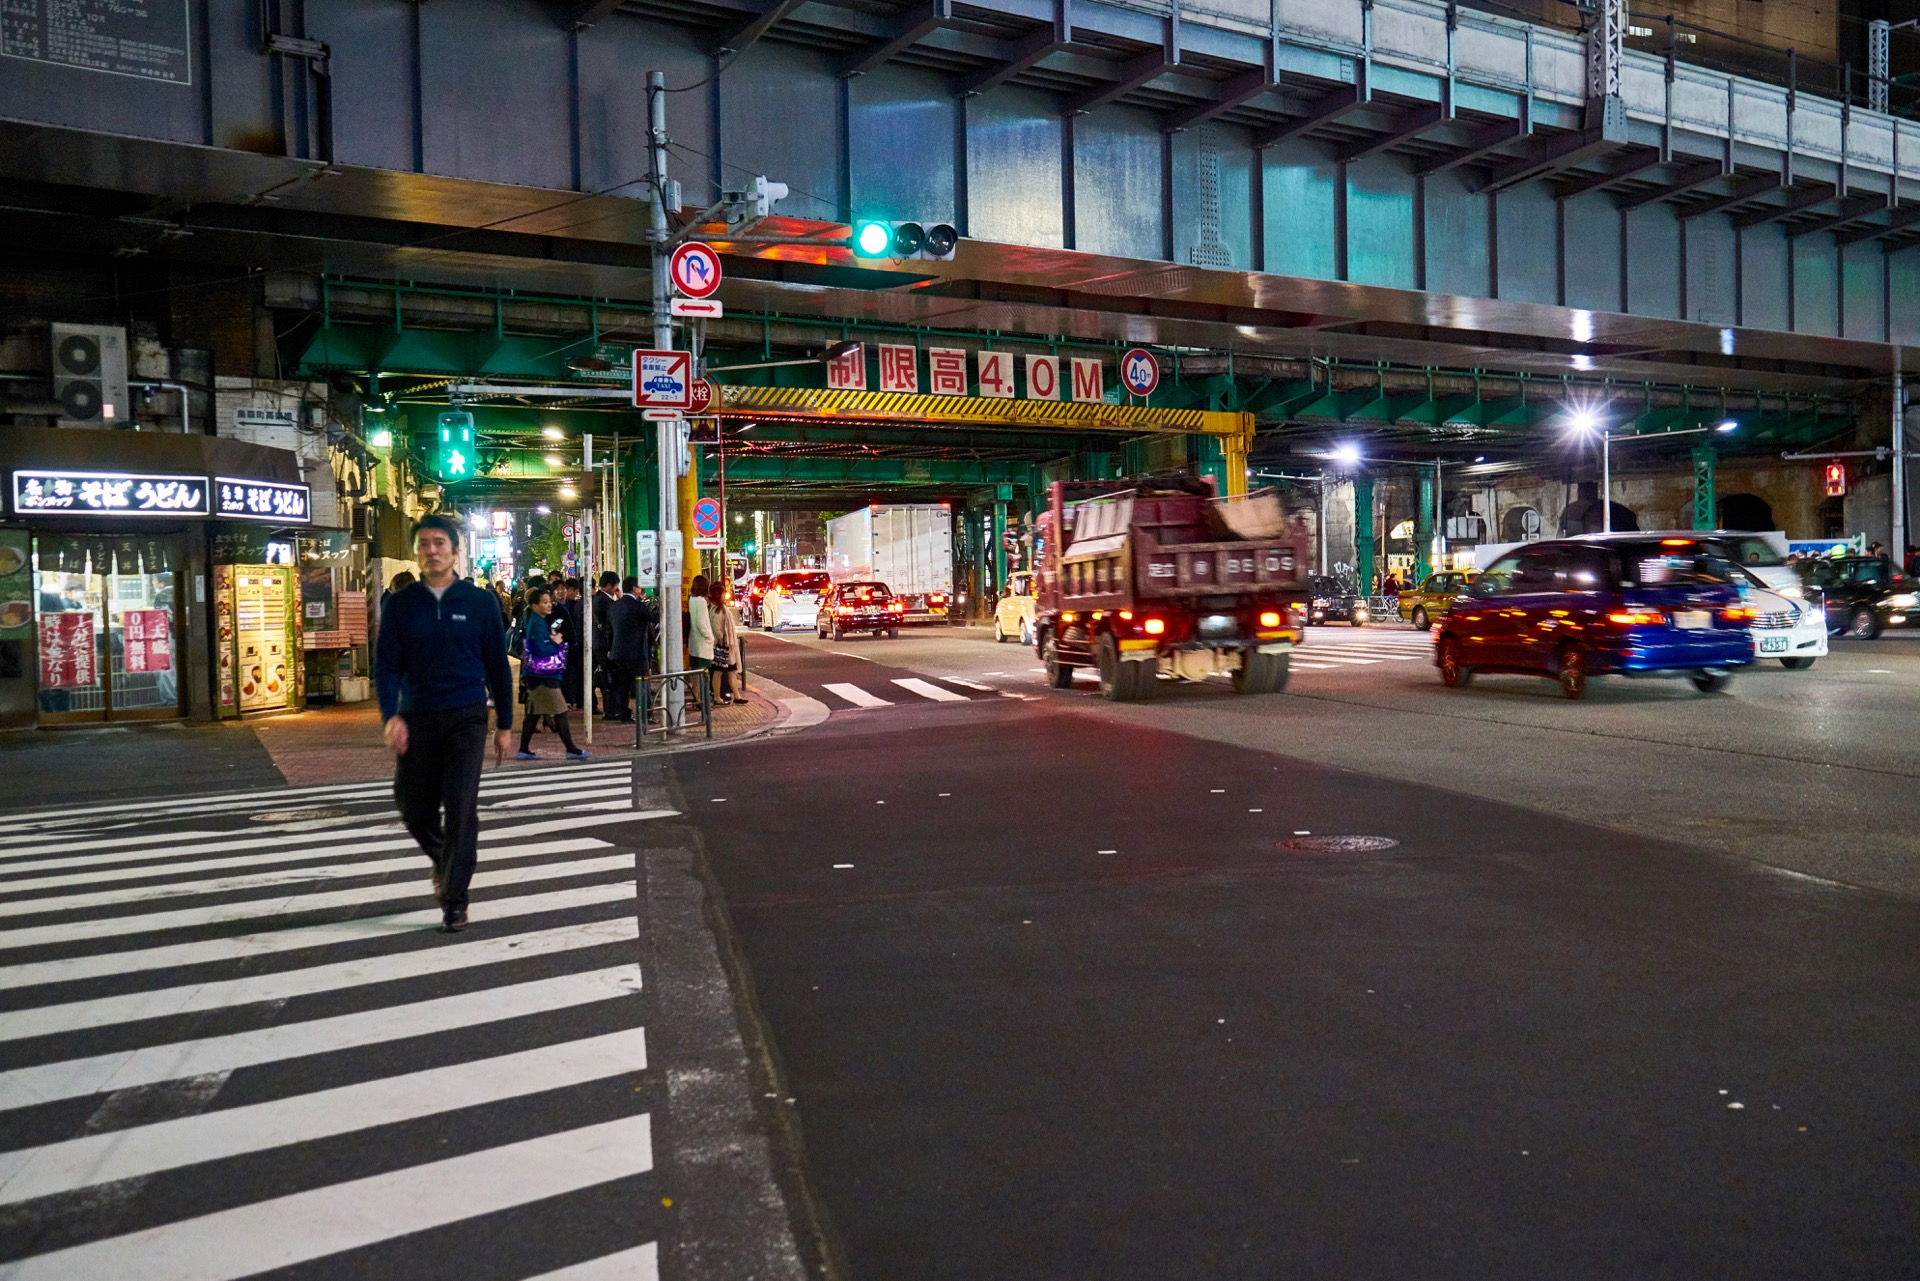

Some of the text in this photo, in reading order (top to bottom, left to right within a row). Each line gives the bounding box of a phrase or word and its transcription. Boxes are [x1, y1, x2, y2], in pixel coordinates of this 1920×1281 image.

[78, 480, 200, 509] そば うどん
[247, 488, 304, 515] そば うどん
[95, 542, 106, 570] うどん
[129, 613, 146, 669] 0円無料
